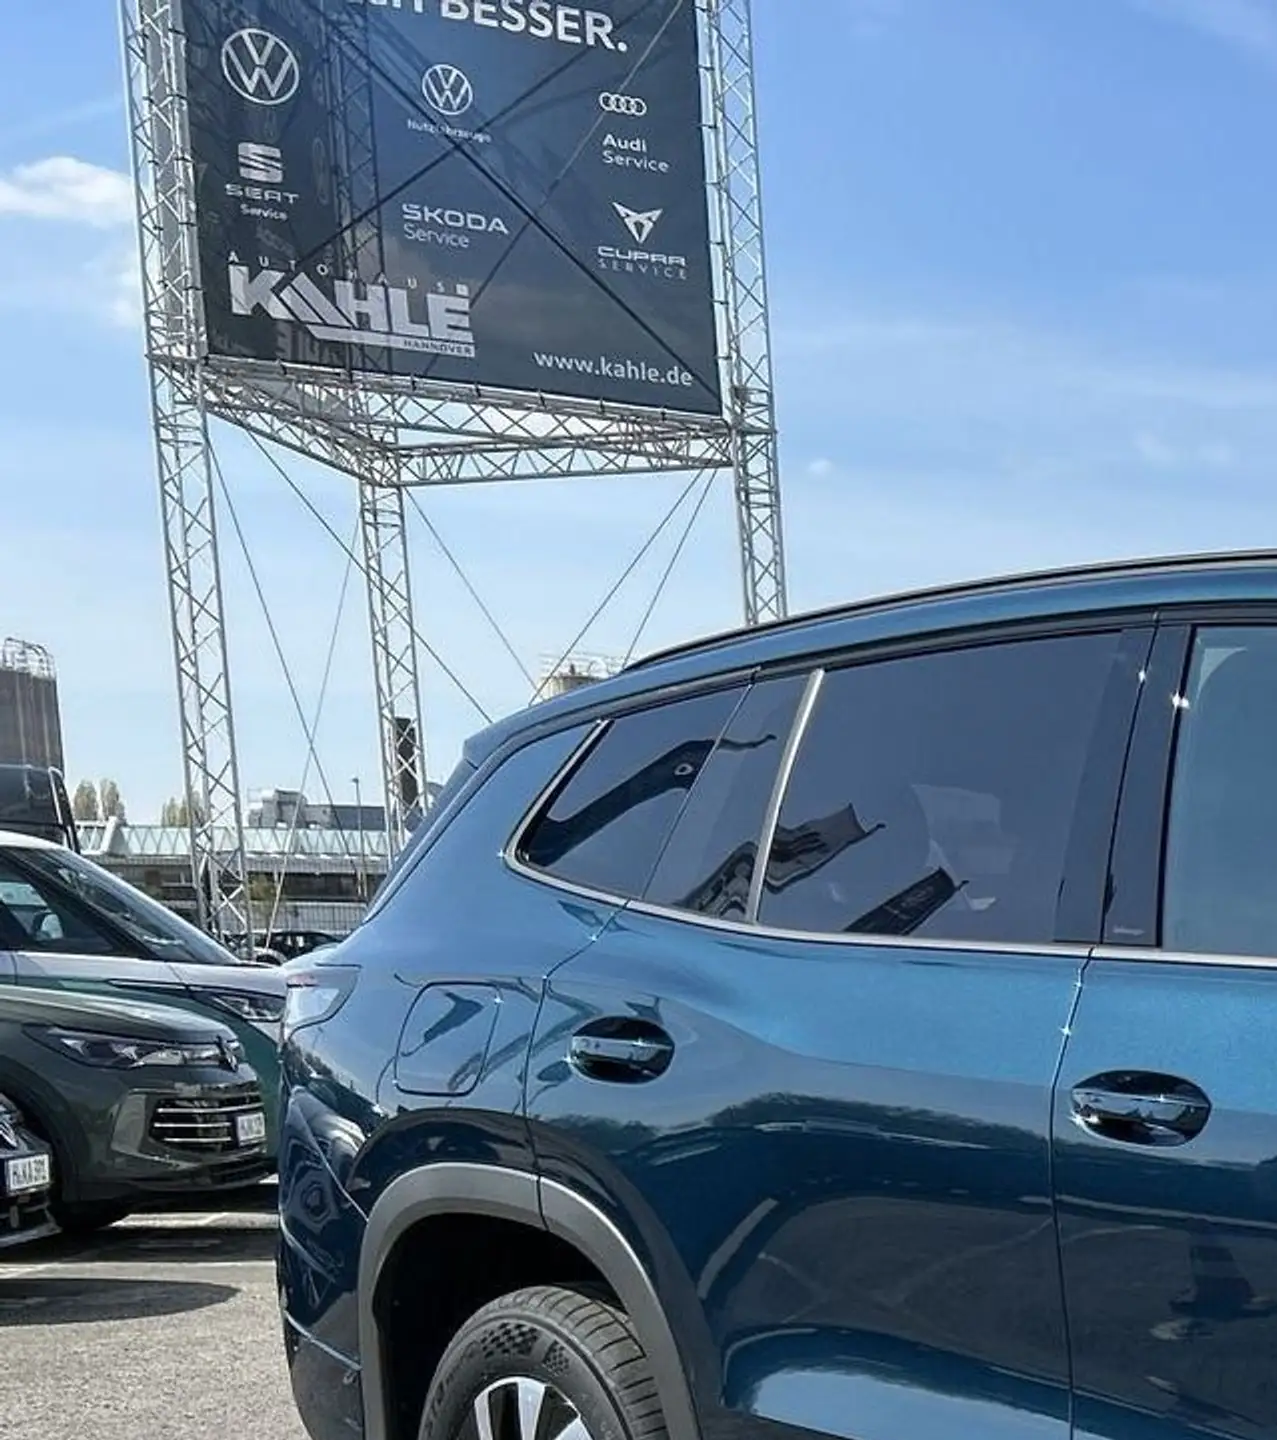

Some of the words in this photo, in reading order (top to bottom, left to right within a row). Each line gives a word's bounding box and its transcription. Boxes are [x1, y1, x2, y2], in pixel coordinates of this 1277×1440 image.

[602, 133, 648, 152] Audi
[602, 150, 670, 173] Service
[225, 183, 299, 204] SEAT
[239, 203, 288, 221] Service
[403, 222, 470, 248] Service
[597, 245, 687, 266] CUPRA
[598, 258, 688, 280] SERVICE
[403, 338, 473, 356] HANNOVER
[533, 352, 694, 386] www.kahle.de
